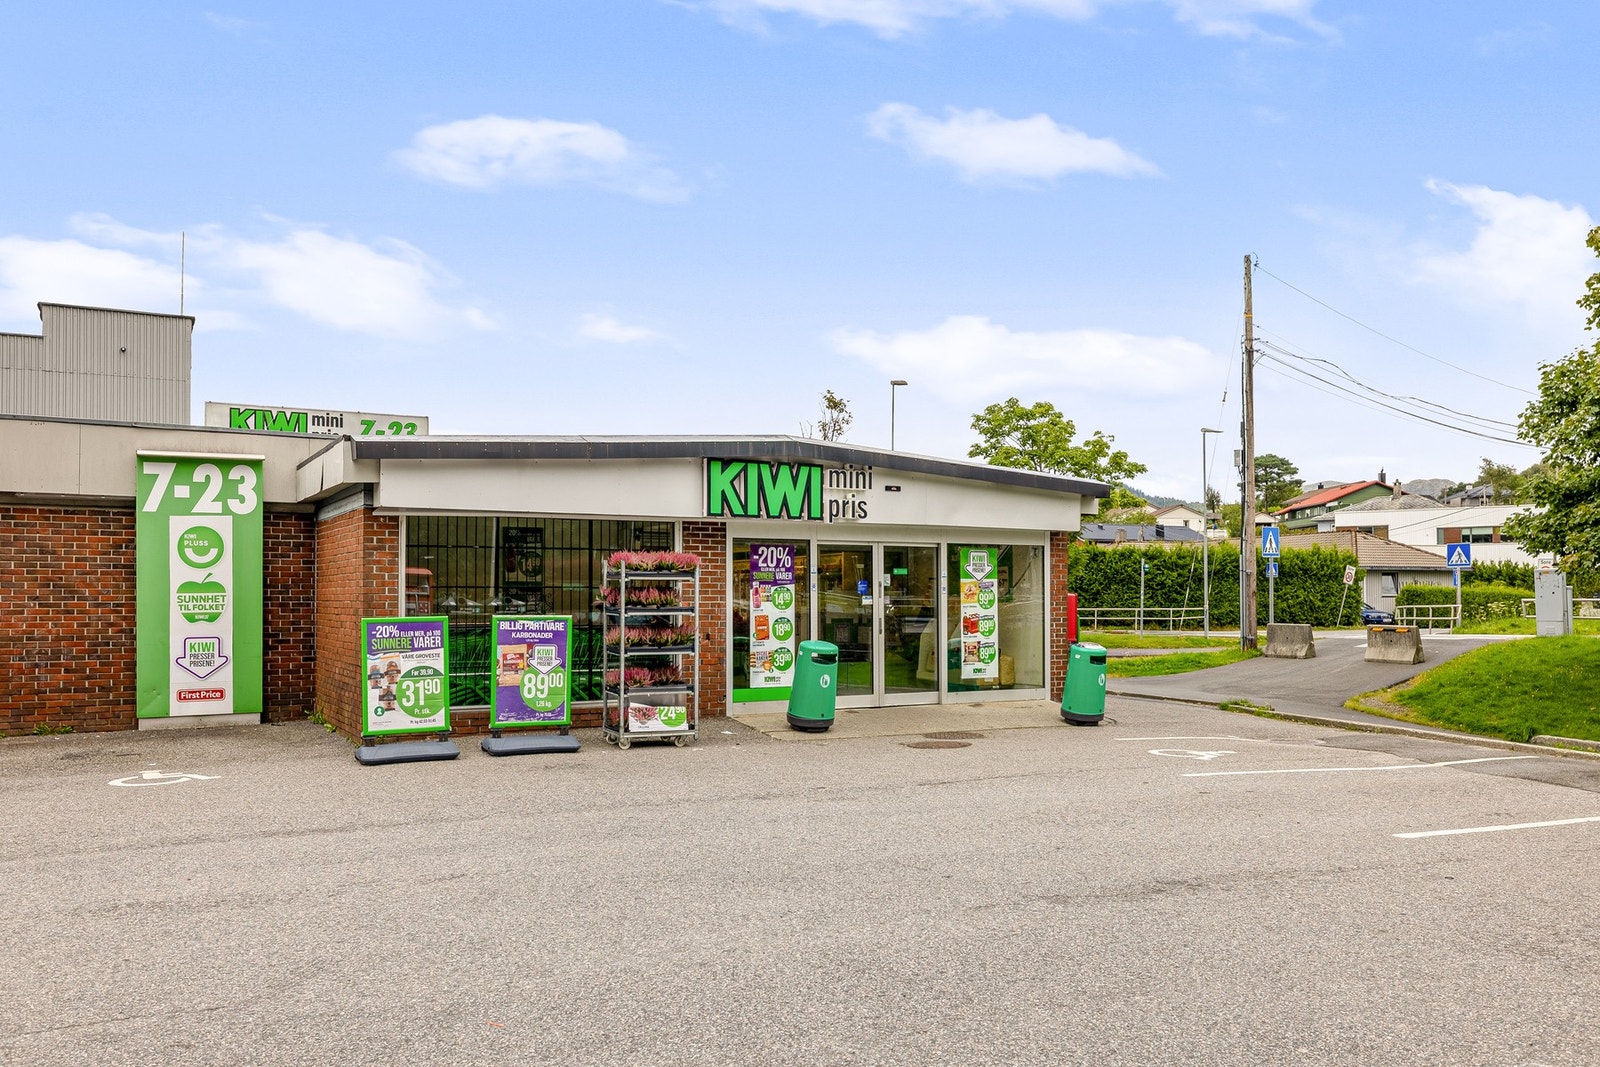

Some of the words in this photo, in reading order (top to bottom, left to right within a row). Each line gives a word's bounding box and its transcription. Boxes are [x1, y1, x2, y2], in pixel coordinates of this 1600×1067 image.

[230, 408, 308, 432] KIWI
[312, 413, 344, 428] mini
[142, 462, 258, 514] 7-23
[707, 458, 824, 520] KIWI
[829, 464, 872, 490] mini
[829, 494, 868, 522] pris
[753, 546, 791, 568] -20%
[776, 572, 792, 580] VARER
[176, 594, 226, 604] SUNNHET
[372, 625, 399, 638] -20%
[500, 622, 523, 630] BILLIG
[524, 622, 564, 630] PARTIVARE
[189, 642, 215, 652] KIWI
[372, 638, 412, 650] SUNNERE
[414, 636, 441, 648] VARER
